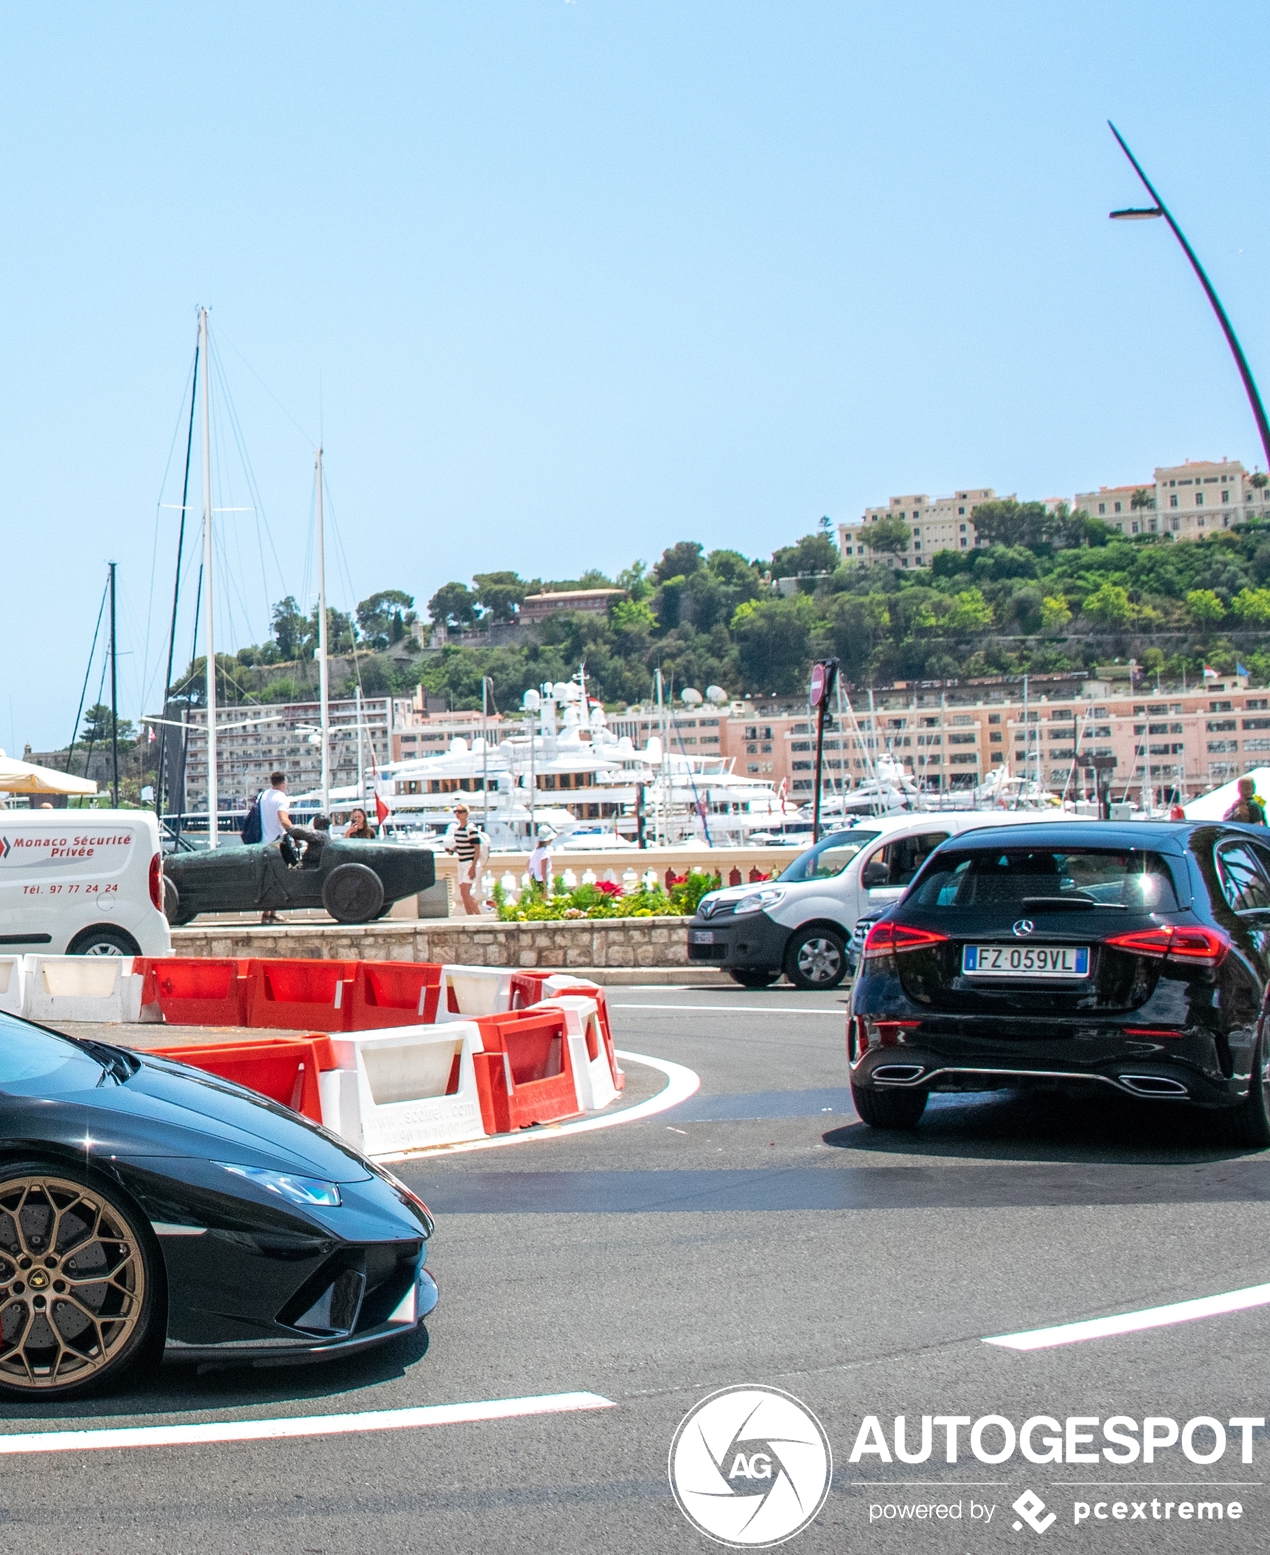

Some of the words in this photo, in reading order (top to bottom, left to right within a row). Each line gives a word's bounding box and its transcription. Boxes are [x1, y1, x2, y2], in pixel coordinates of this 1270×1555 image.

[13, 838, 67, 848] Monaco
[73, 834, 131, 847] Sécurité
[50, 847, 94, 858] Privée
[23, 885, 44, 895] Tél.
[49, 885, 63, 894] 97
[68, 884, 80, 893] 77
[85, 884, 99, 893] 24
[105, 884, 118, 893] 24
[978, 949, 1003, 968] FZ
[1009, 949, 1073, 970] 059VL
